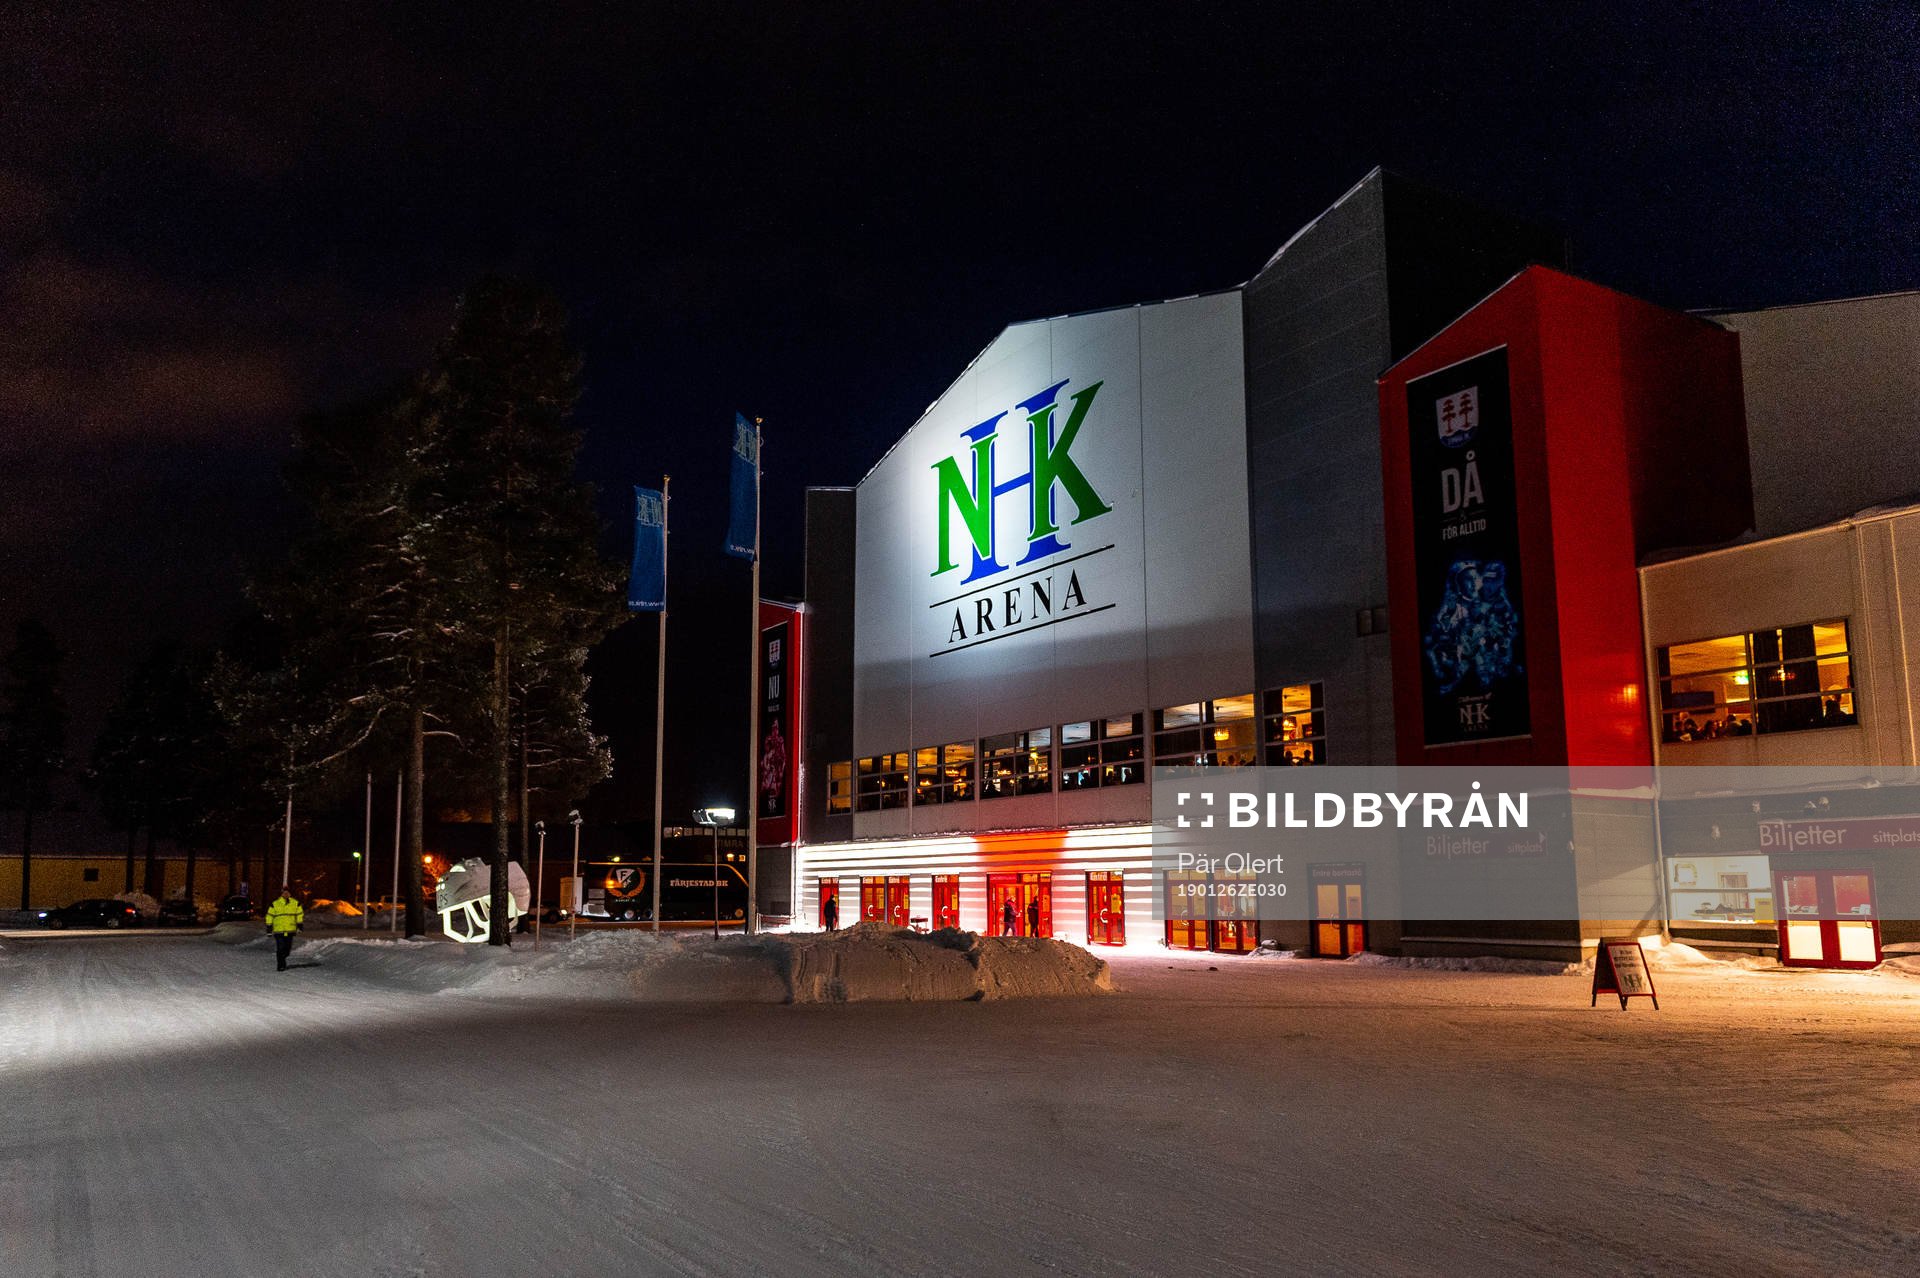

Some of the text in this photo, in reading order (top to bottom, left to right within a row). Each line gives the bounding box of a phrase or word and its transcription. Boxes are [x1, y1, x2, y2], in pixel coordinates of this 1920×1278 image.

[930, 378, 1113, 586] NHK
[1440, 450, 1485, 514] DÅ
[1442, 518, 1487, 542] FÖR ALLTID
[948, 568, 1087, 643] ARENA
[1426, 835, 1490, 859] Biljetter
[1760, 822, 1847, 851] Biljetter
